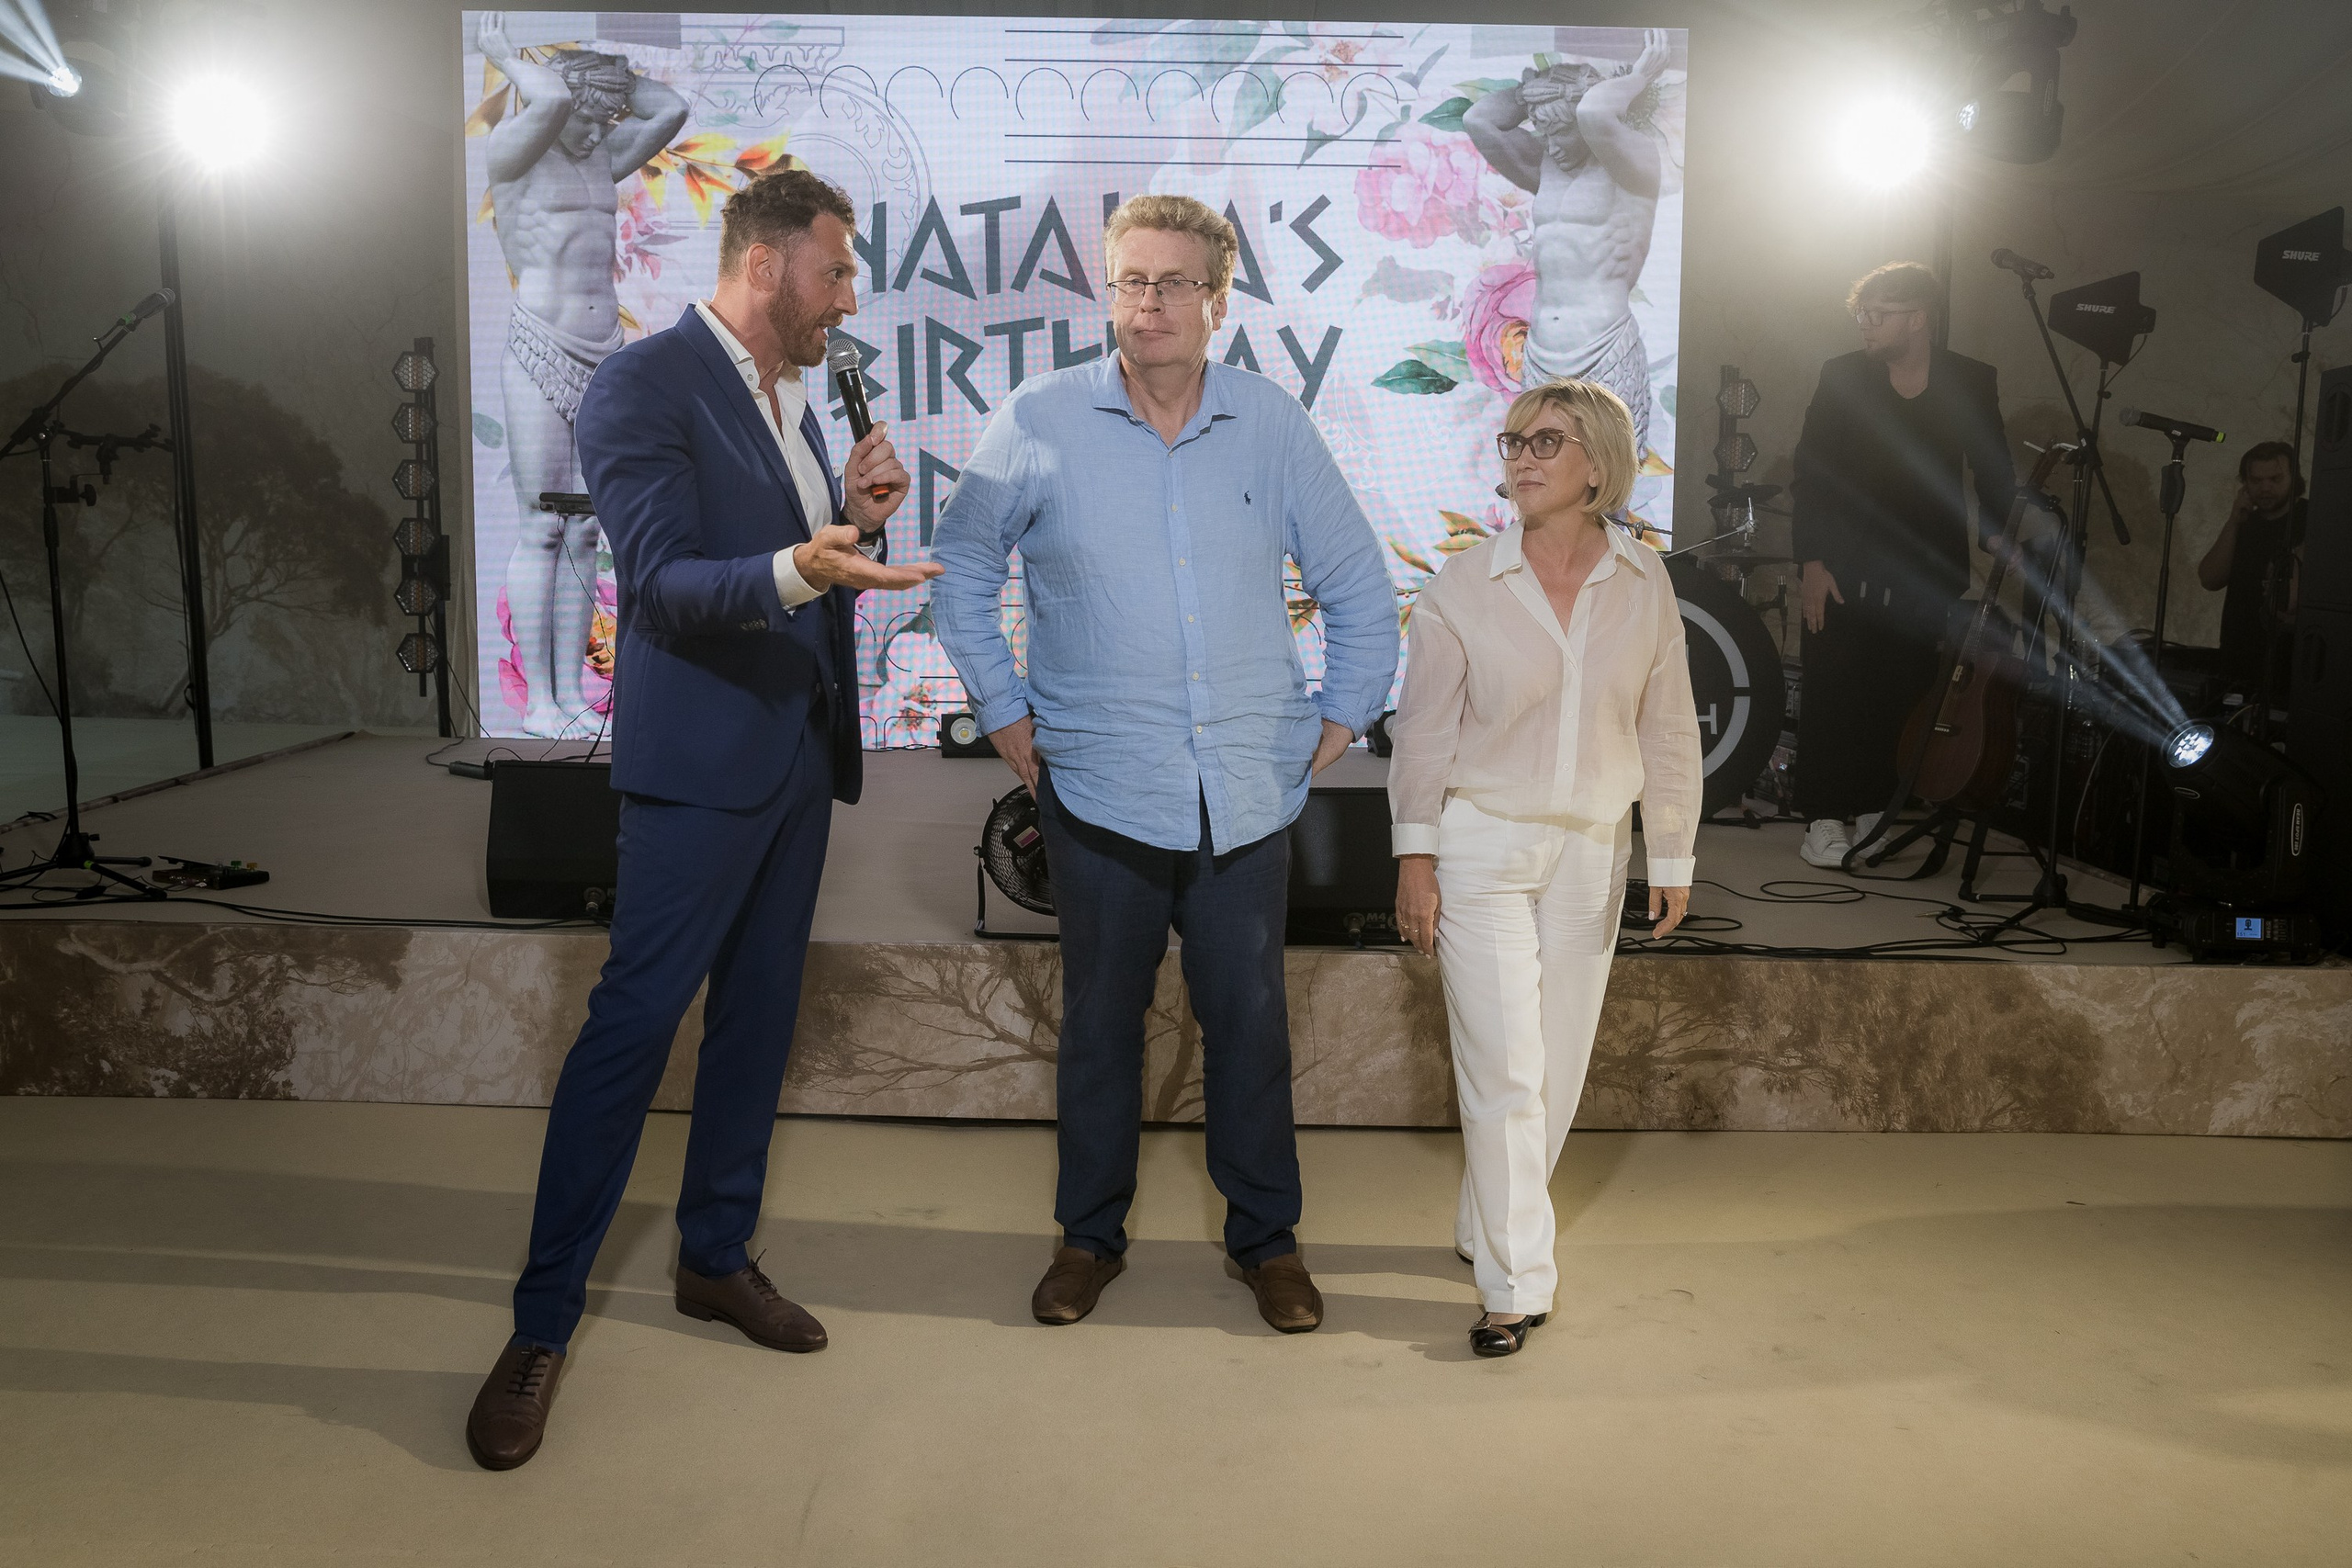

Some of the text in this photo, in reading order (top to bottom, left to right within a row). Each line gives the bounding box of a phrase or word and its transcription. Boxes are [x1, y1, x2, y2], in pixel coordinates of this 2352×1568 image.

[2281, 250, 2321, 262] SHURE
[2075, 303, 2117, 314] SHURE
[828, 315, 1343, 422] BIRTHAY
